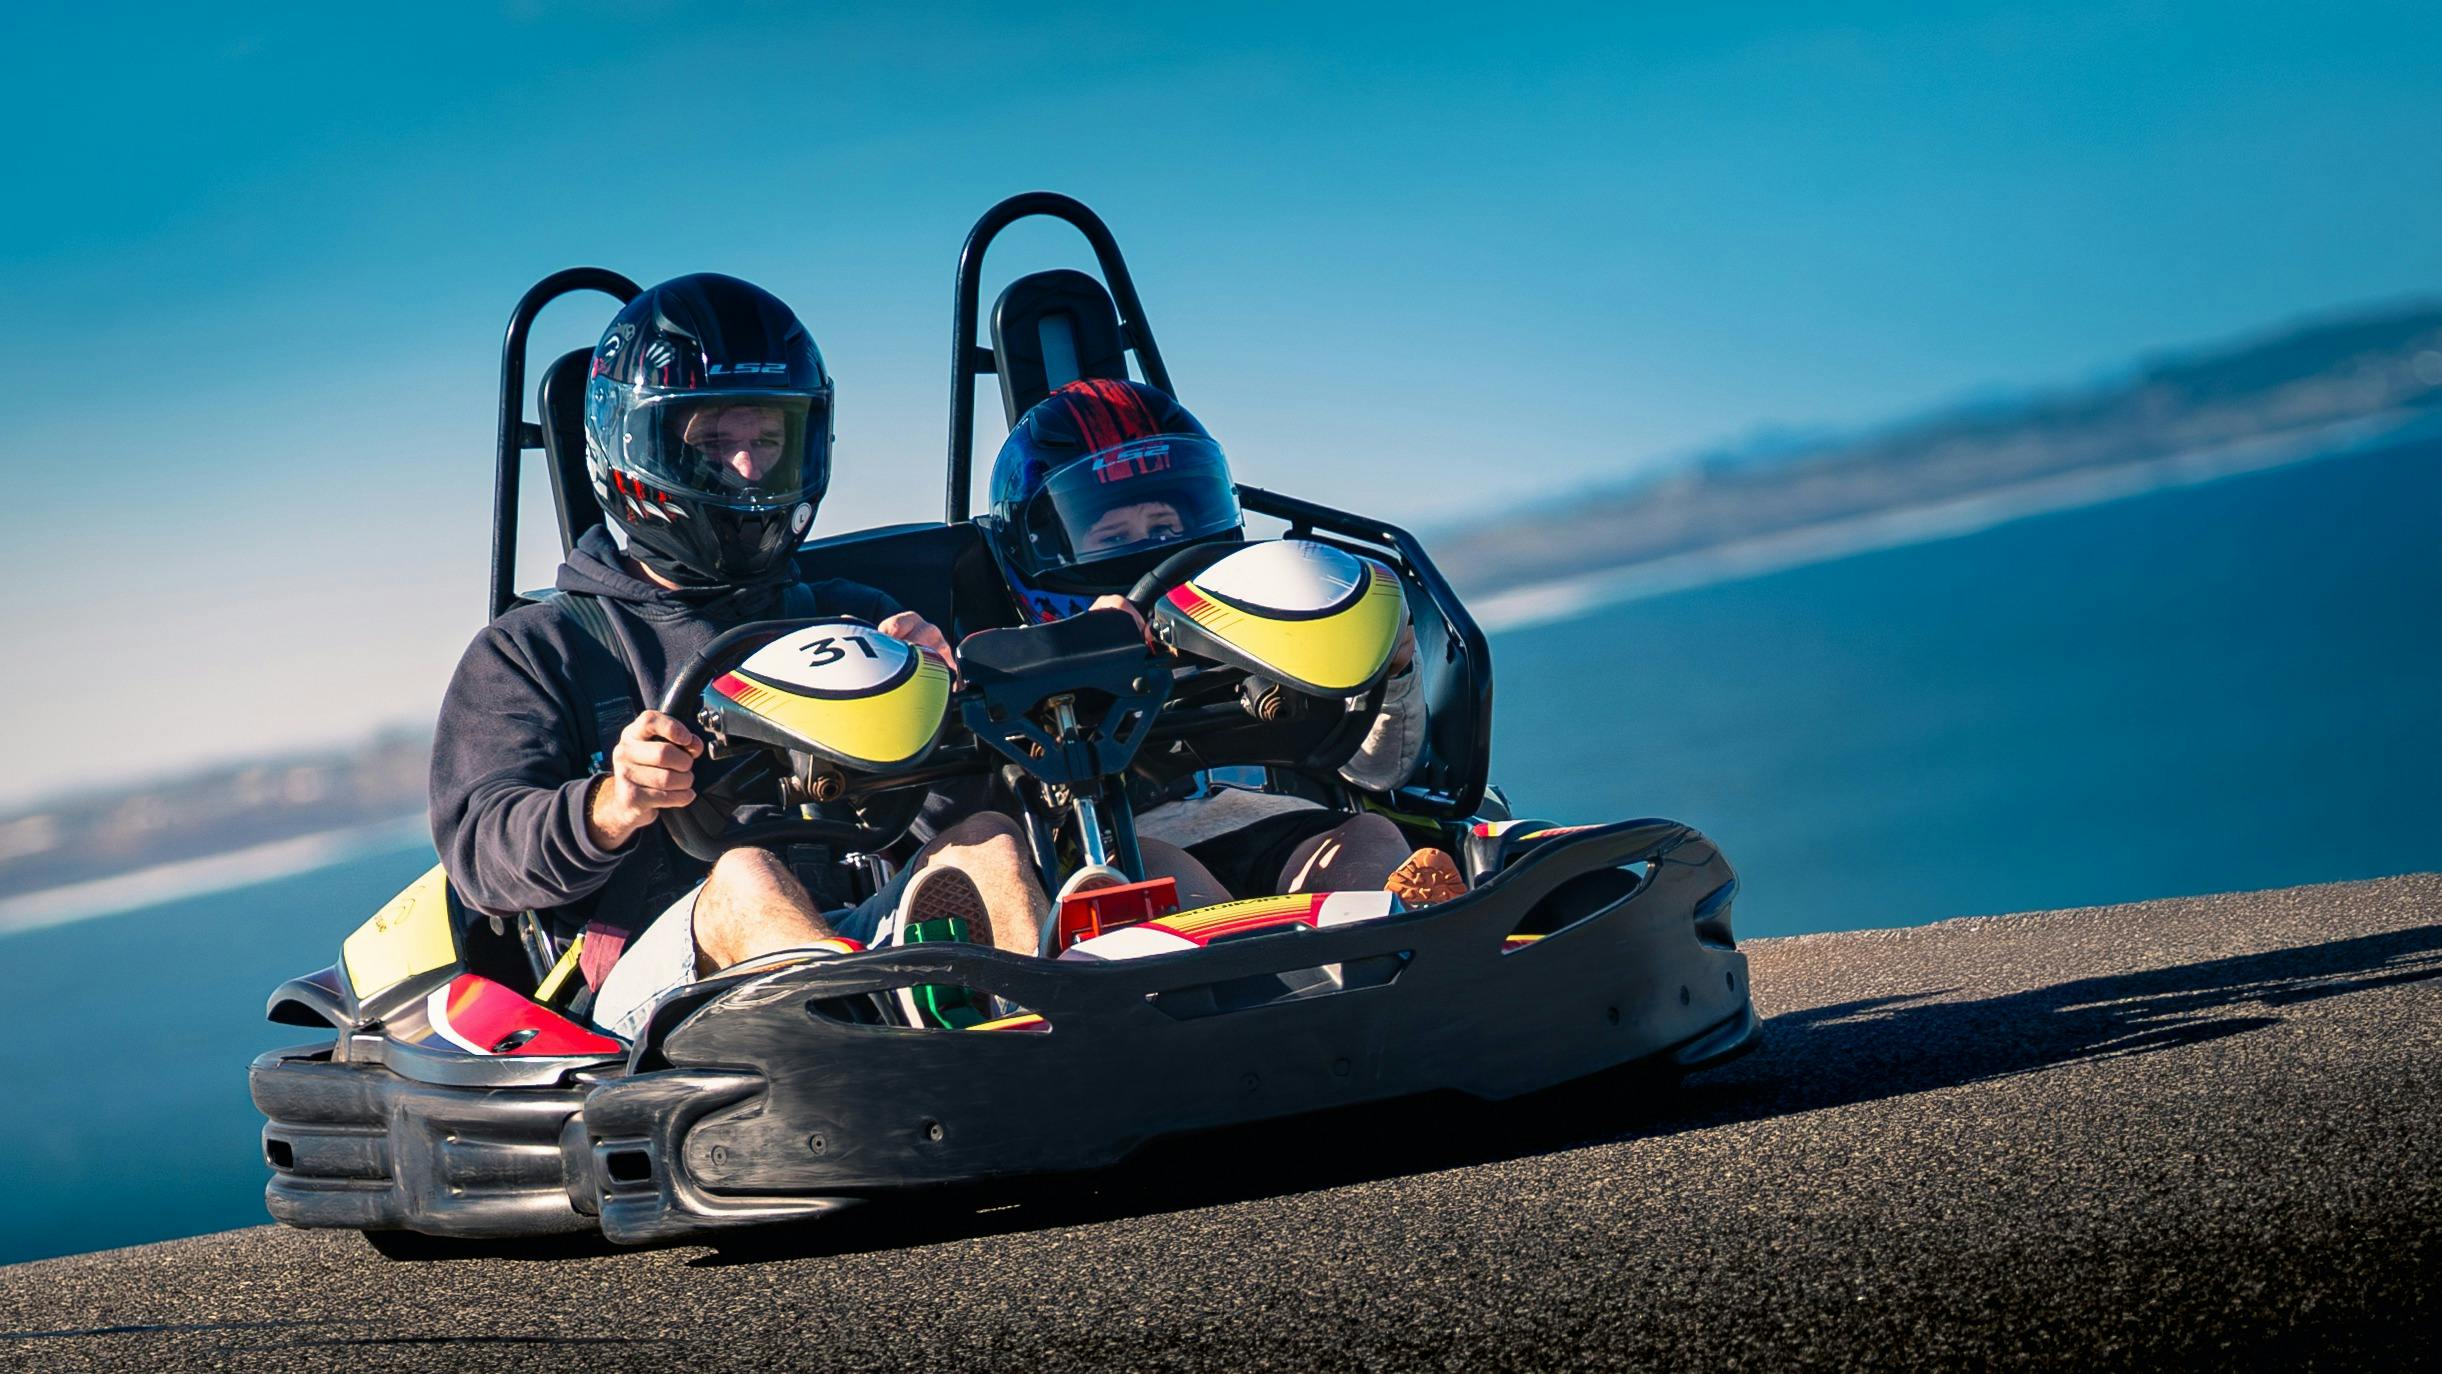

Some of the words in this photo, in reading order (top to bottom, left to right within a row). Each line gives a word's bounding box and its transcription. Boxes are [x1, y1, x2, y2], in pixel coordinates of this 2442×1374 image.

[709, 362, 787, 375] LS2
[1092, 444, 1170, 471] LS2
[798, 635, 879, 668] 31
